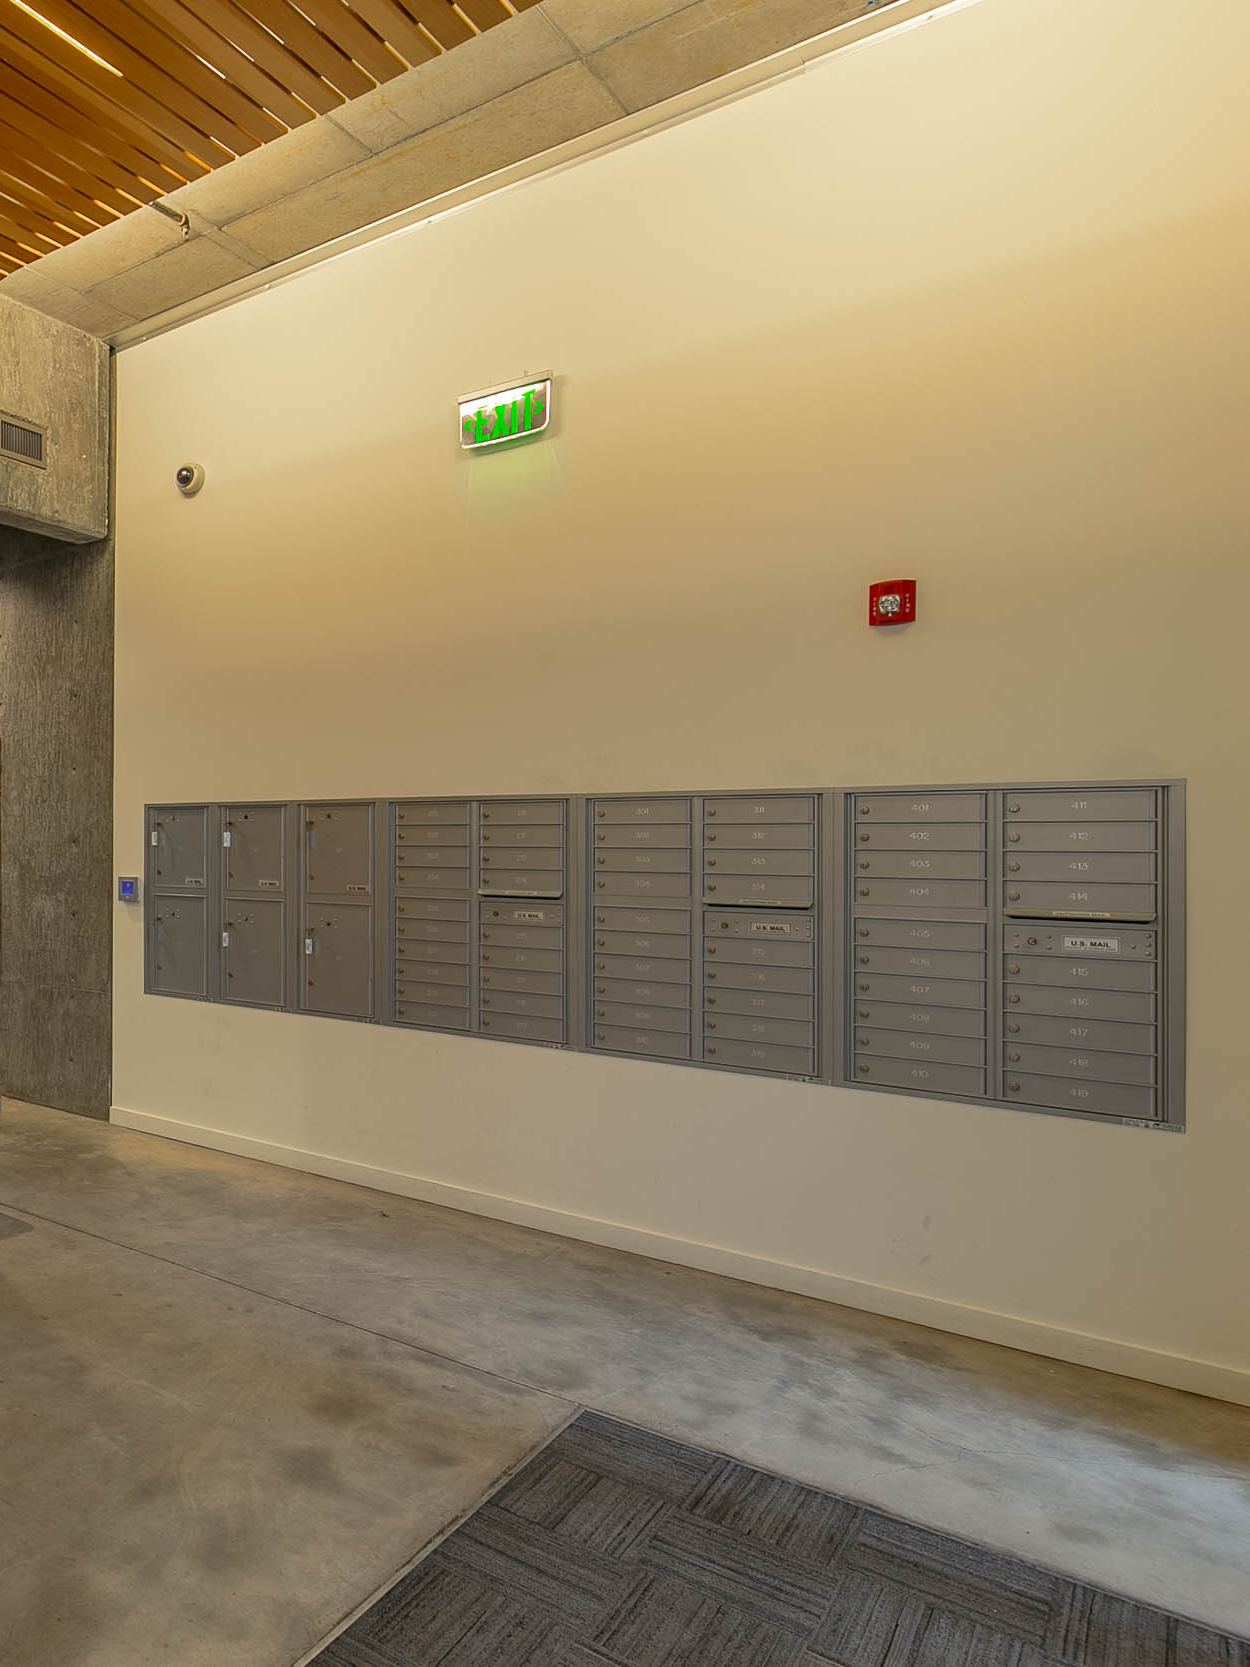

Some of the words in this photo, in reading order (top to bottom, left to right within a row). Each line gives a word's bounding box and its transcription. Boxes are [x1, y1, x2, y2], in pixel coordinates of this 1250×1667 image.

[475, 389, 536, 443] EXIT
[910, 804, 930, 812] 401
[1070, 802, 1088, 810] 411
[910, 832, 930, 840] 402
[1070, 832, 1088, 840] 412
[910, 860, 930, 868] 403
[1070, 862, 1088, 871] 413
[910, 888, 930, 896] 404
[1070, 892, 1088, 901] 414
[1070, 968, 1088, 976] 415
[910, 985, 930, 993] 407
[1070, 1028, 1088, 1036] 417
[910, 1070, 930, 1079] 410
